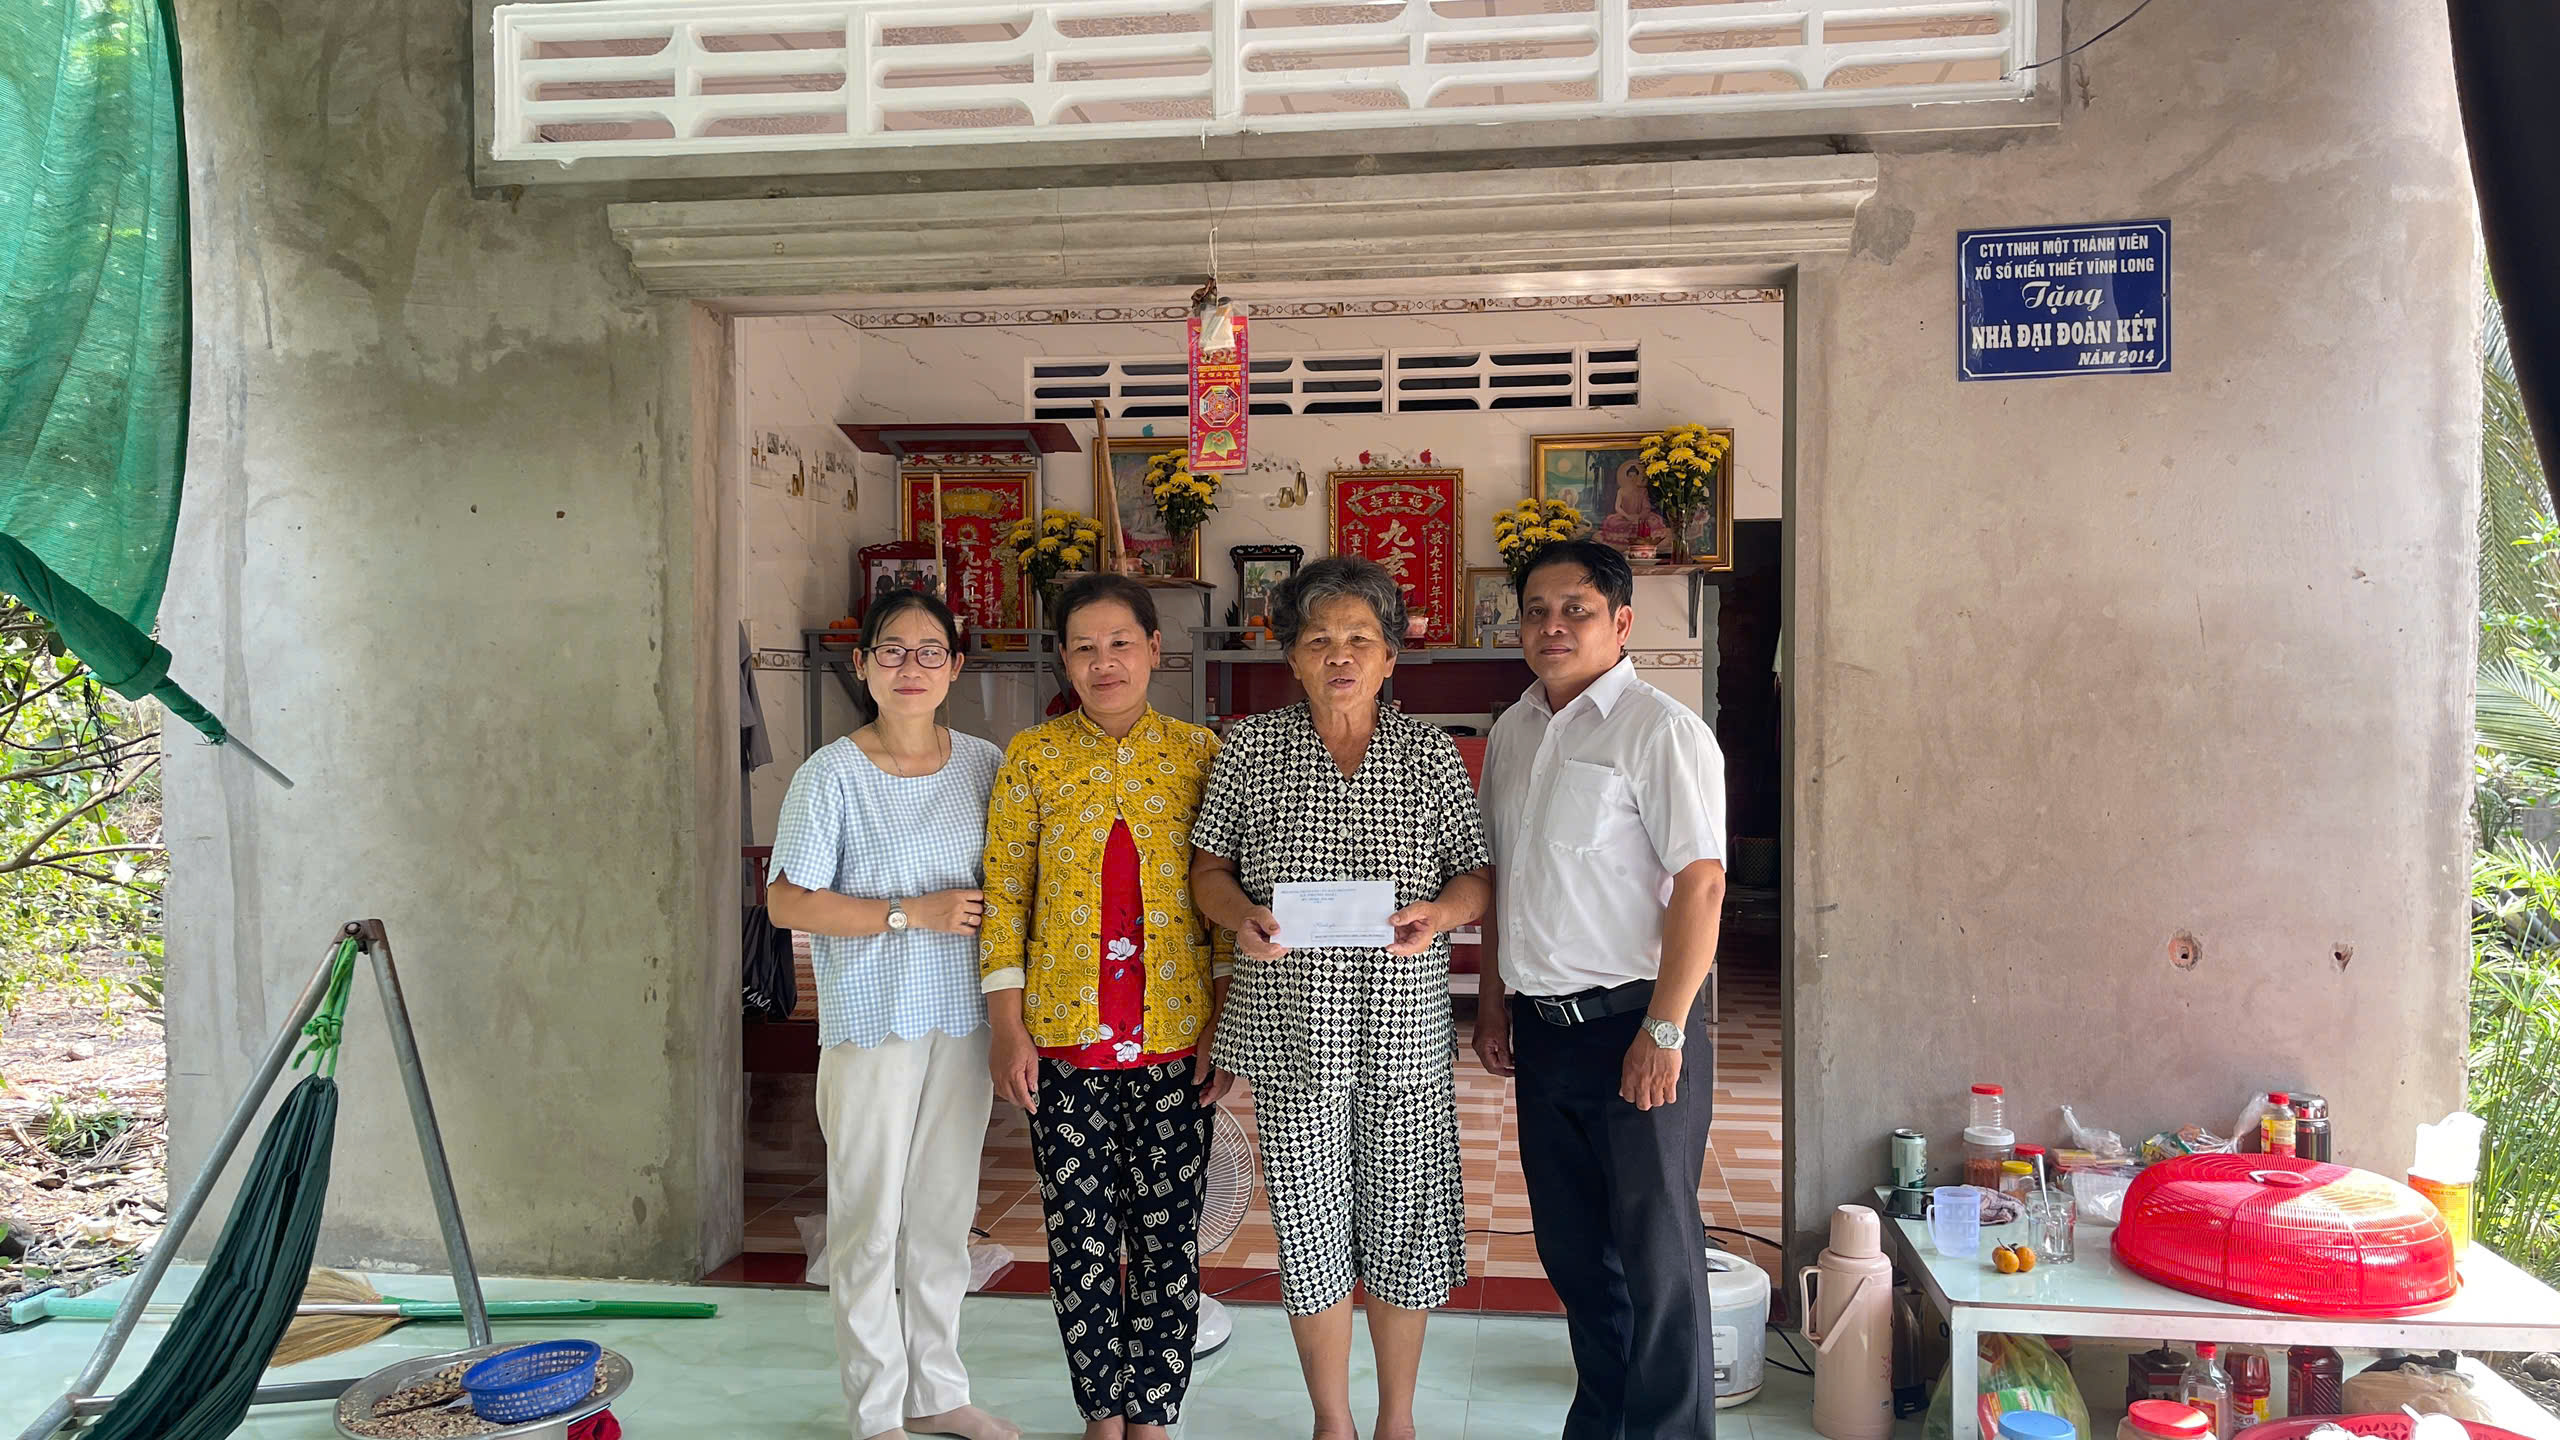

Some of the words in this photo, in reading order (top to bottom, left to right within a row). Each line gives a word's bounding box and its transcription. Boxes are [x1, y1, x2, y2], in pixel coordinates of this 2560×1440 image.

[1980, 243, 2003, 258] CTY
[2006, 241, 2039, 256] TNHH
[2042, 237, 2069, 257] MỘT
[2072, 235, 2115, 253] THÀNH
[2118, 233, 2148, 250] VIÊN
[1975, 260, 1992, 280] XỔ
[1995, 260, 2013, 280] SỐ
[2014, 259, 2045, 278] KIẾN
[2048, 257, 2083, 276] THIẾT
[2086, 258, 2117, 275] VĨNH
[2120, 257, 2155, 273] LONG
[2021, 281, 2105, 315] Tặng
[1971, 319, 2013, 350] NHÀ
[2017, 323, 2052, 353] ĐẠI
[2056, 315, 2112, 346] ĐOÀN
[2116, 309, 2157, 343] KẾT
[2078, 349, 2115, 366] NĂM
[2118, 349, 2155, 364] 2014
